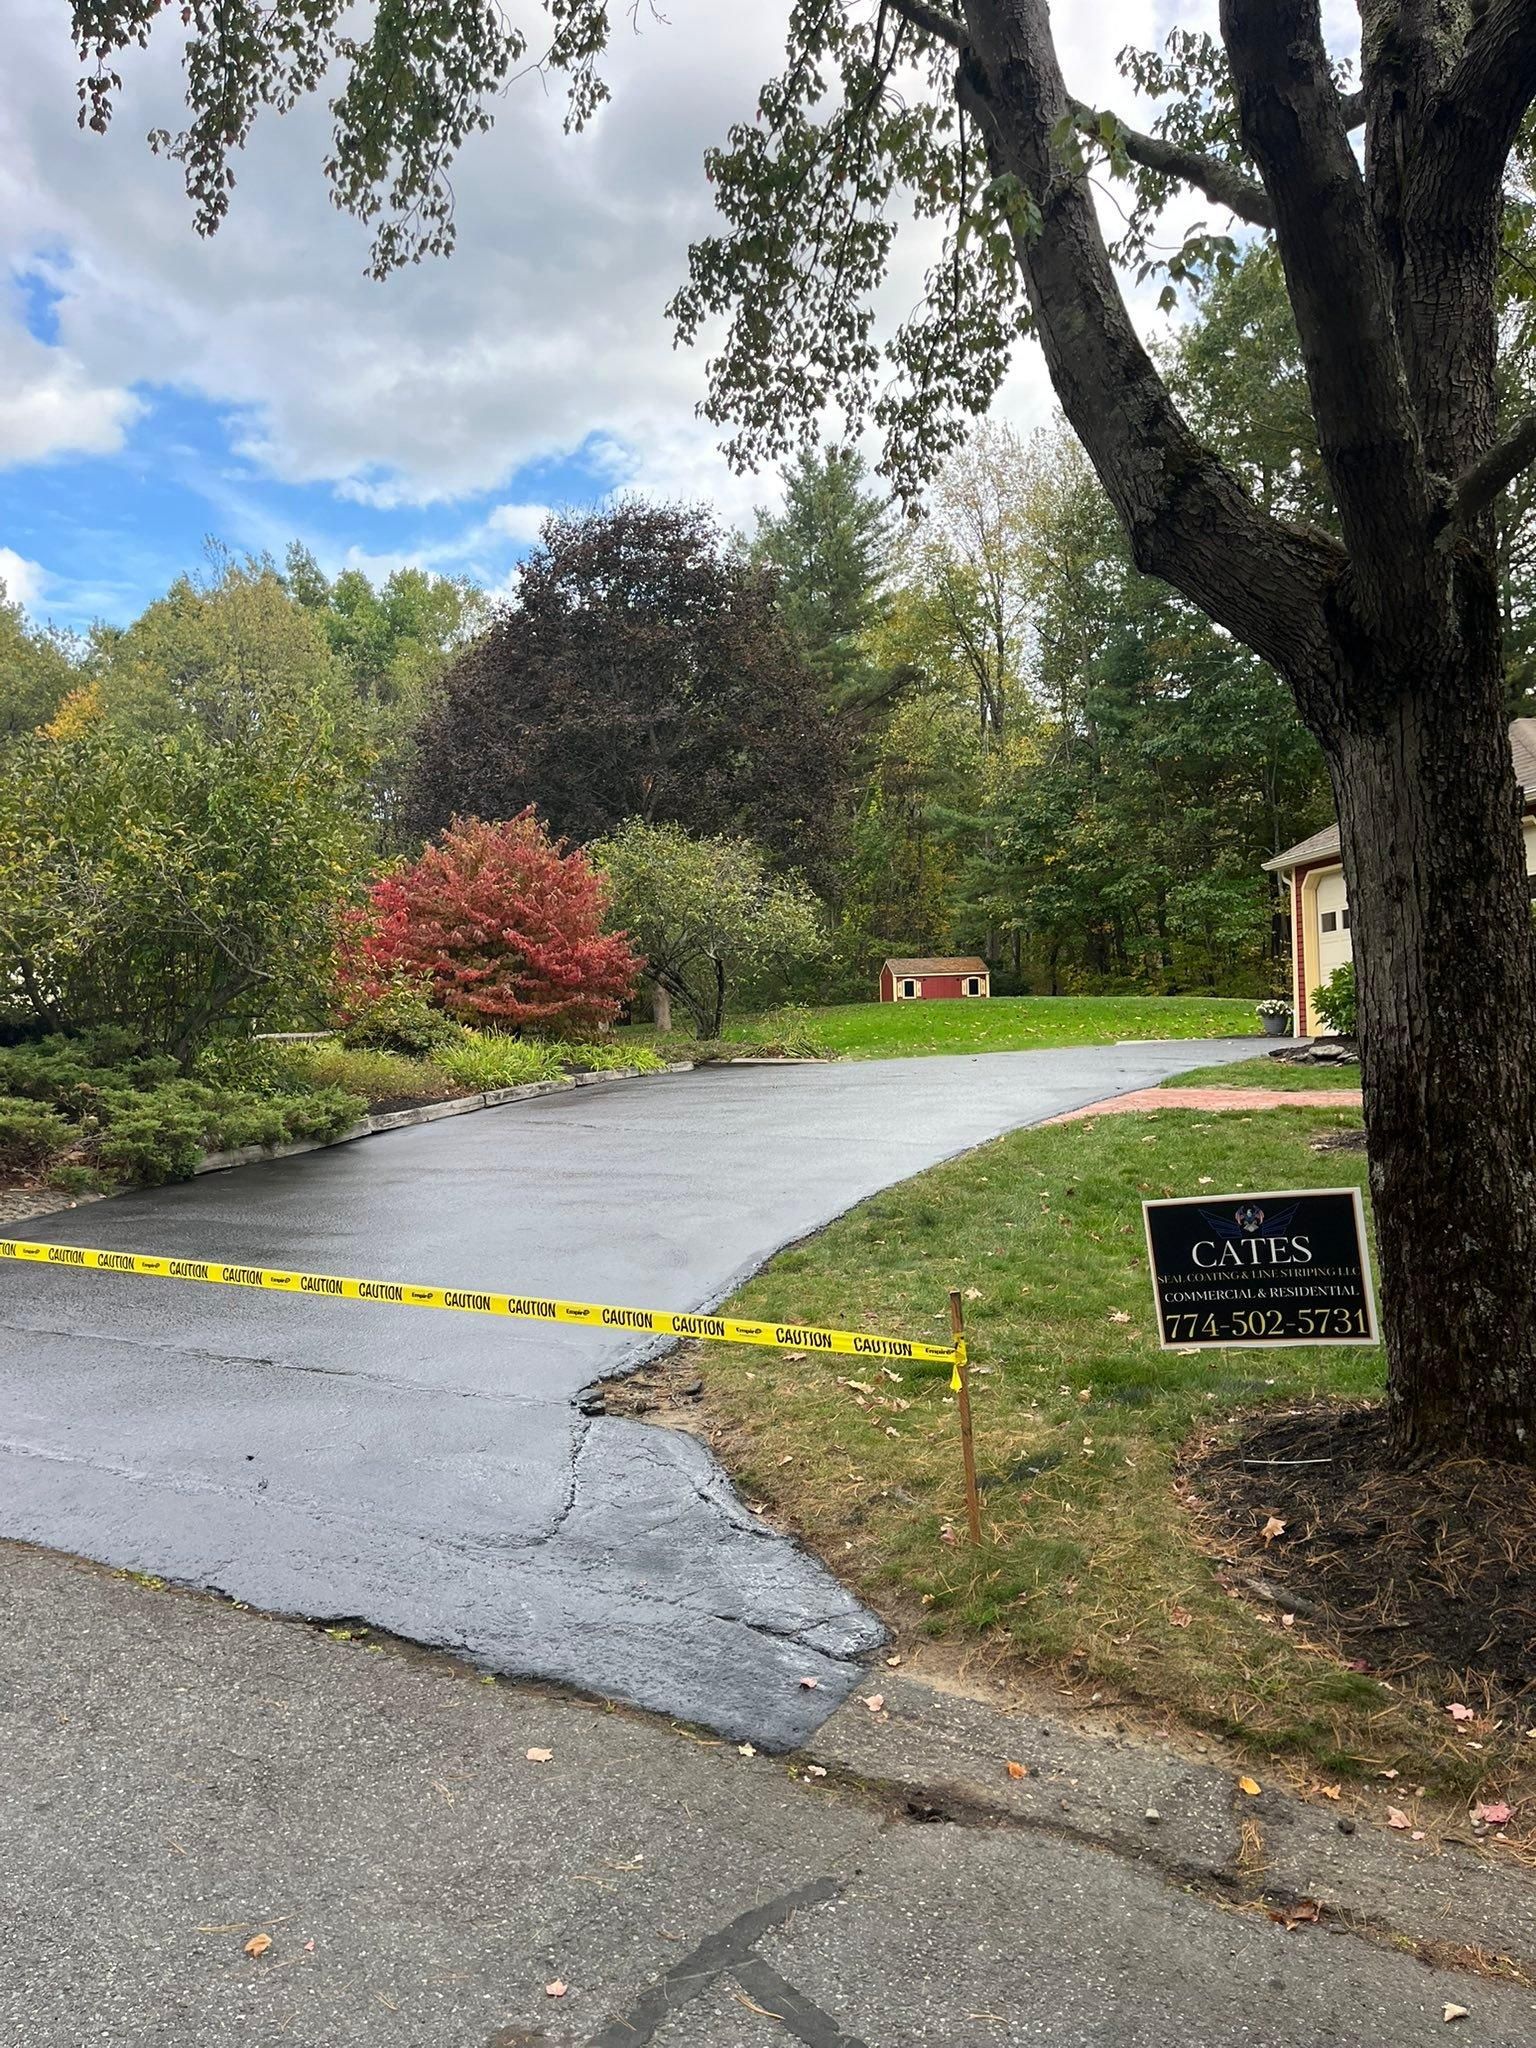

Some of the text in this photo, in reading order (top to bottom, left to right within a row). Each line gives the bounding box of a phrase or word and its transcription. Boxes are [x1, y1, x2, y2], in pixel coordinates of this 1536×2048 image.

[1191, 1235, 1313, 1268] CATES
[1157, 1266, 1360, 1284] SEAL COATING & LINE STRIPING LLC
[48, 1248, 85, 1264] CAUTION
[97, 1253, 136, 1270] CAUTION
[169, 1261, 209, 1278] CAUTION
[222, 1267, 263, 1285] CAUTION
[301, 1276, 344, 1295] CAUTION
[358, 1282, 403, 1301] CAUTION
[444, 1291, 491, 1311] CAUTION
[508, 1298, 556, 1318] CAUTION
[602, 1308, 653, 1329] CAUTION
[672, 1316, 725, 1337] CAUTION
[776, 1327, 832, 1349] CAUTION
[853, 1337, 913, 1357] CAUTION
[1164, 1285, 1360, 1302] COMMERCIAL & RESIDENTIAL
[1166, 1308, 1368, 1339] 774-502-5731
